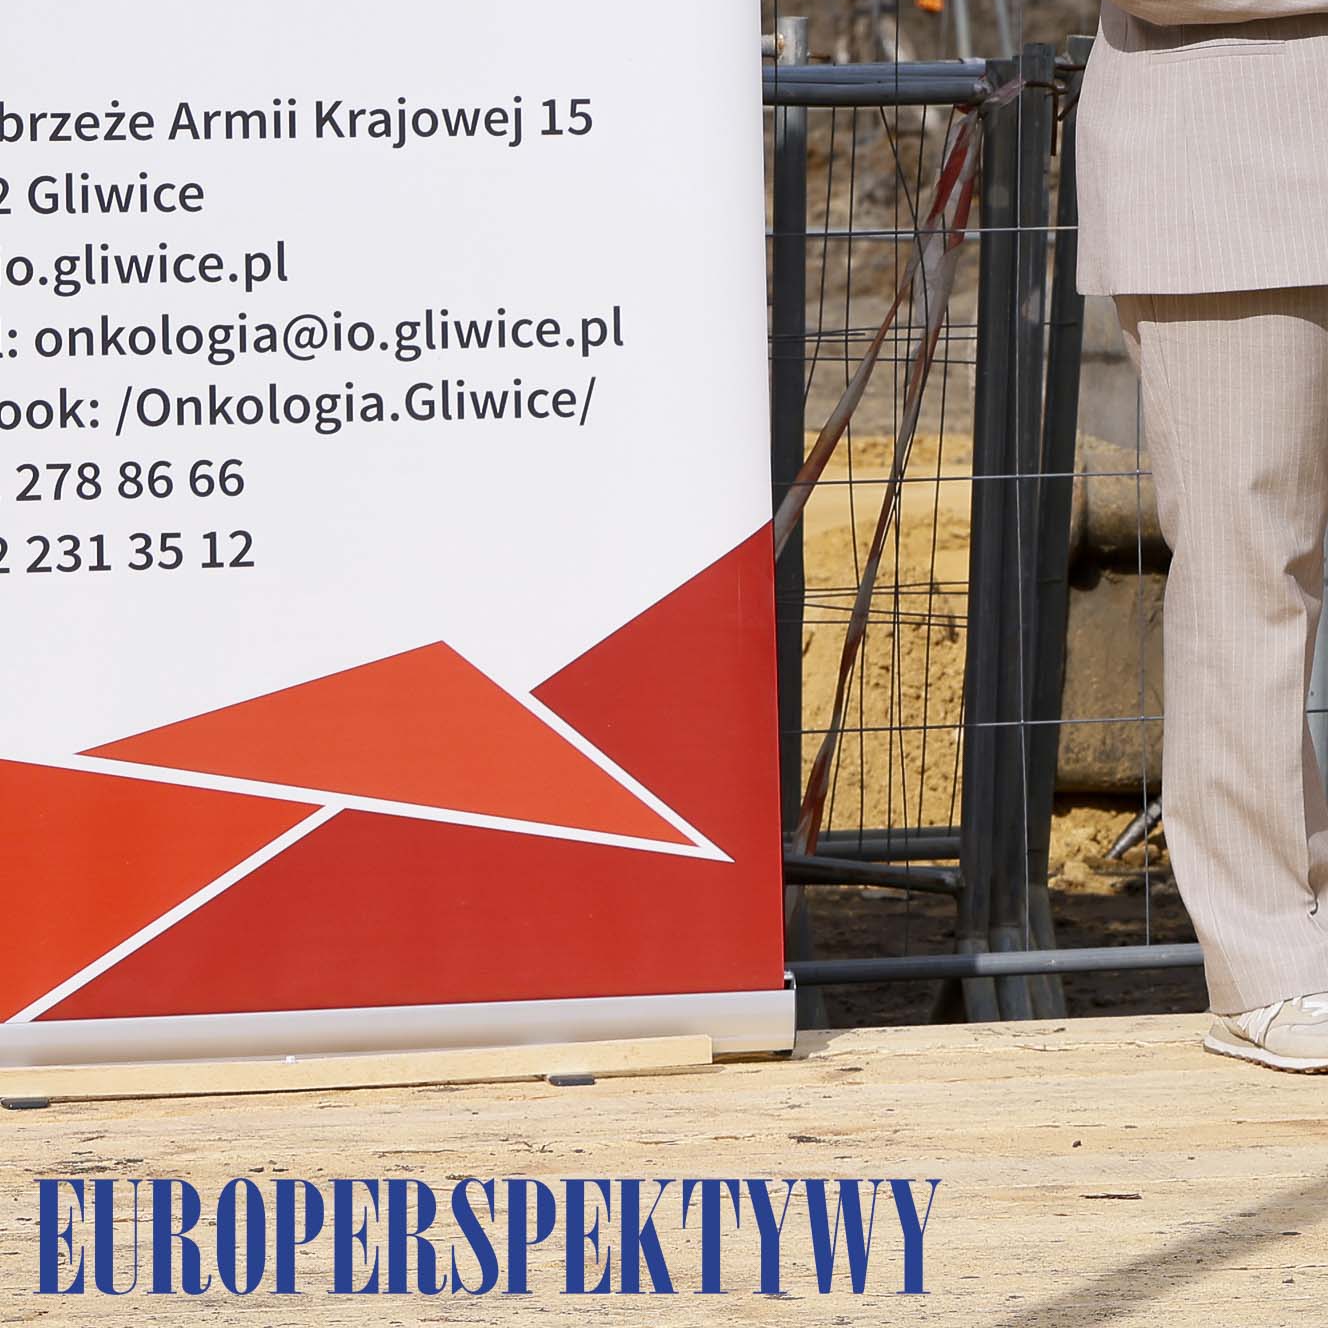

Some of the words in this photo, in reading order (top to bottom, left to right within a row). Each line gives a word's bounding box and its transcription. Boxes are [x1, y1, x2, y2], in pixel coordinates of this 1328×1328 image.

[0, 99, 155, 143] brzeże
[168, 97, 297, 140] Armii
[315, 95, 522, 149] Krajowej
[541, 98, 593, 136] 15
[27, 171, 204, 215] Gliwice
[5, 240, 288, 297] o.gliwice.pl
[34, 305, 624, 366] onkologia@io.gliwice.pl
[0, 387, 99, 431] ook:
[115, 376, 596, 437] /Onkologia.Gliwice/
[15, 462, 102, 502] 278
[117, 460, 174, 499] 86
[189, 458, 245, 498] 66
[26, 534, 112, 573] 231
[127, 532, 184, 571] 35
[201, 529, 255, 569] 12
